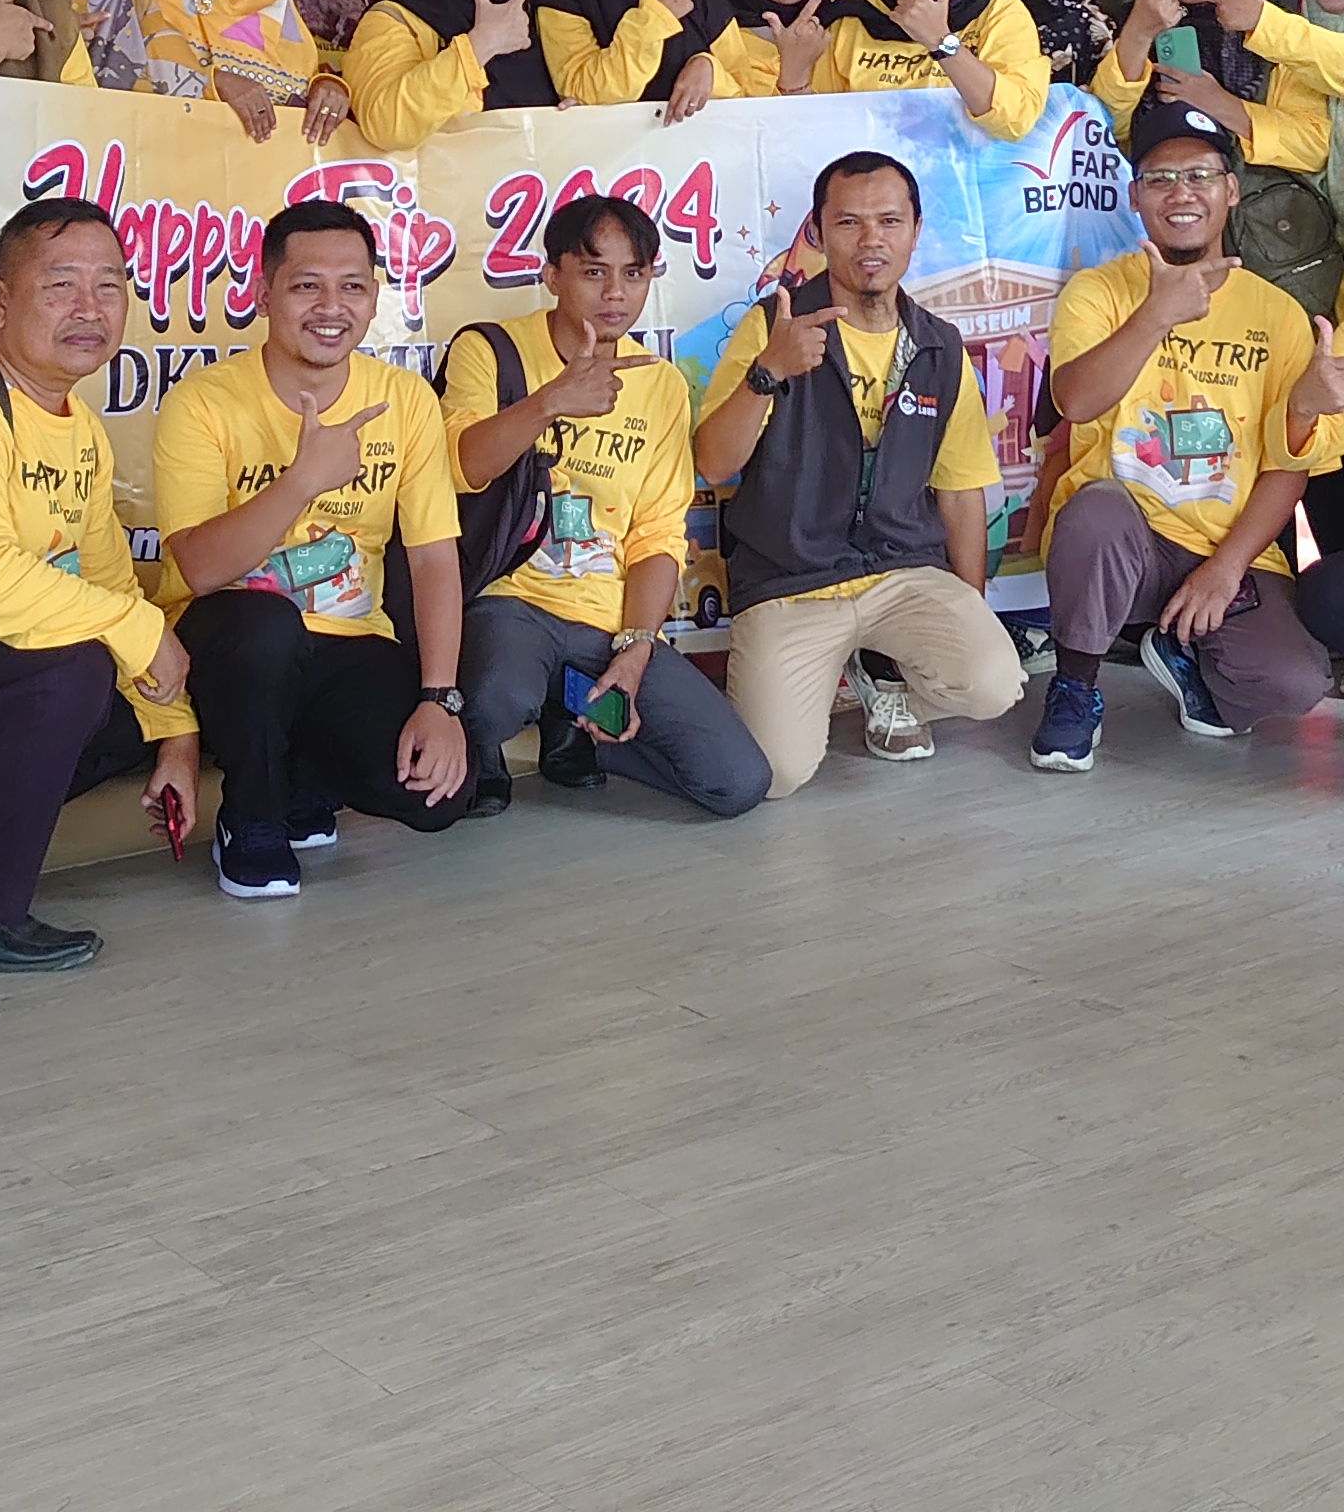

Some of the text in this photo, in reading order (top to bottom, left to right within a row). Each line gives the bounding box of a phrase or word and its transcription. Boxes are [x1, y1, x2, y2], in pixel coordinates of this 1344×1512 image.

[858, 51, 928, 72] HAPP
[1071, 149, 1121, 181] FAR
[1023, 181, 1119, 214] BEYOND
[284, 159, 457, 331] Tip
[483, 157, 723, 288] 224
[1211, 341, 1270, 373] TRIP
[103, 347, 250, 413] DK
[365, 441, 395, 457] 2024
[595, 429, 645, 464] TRIP
[340, 461, 397, 495] RIP
[564, 456, 616, 480] MUSASHI
